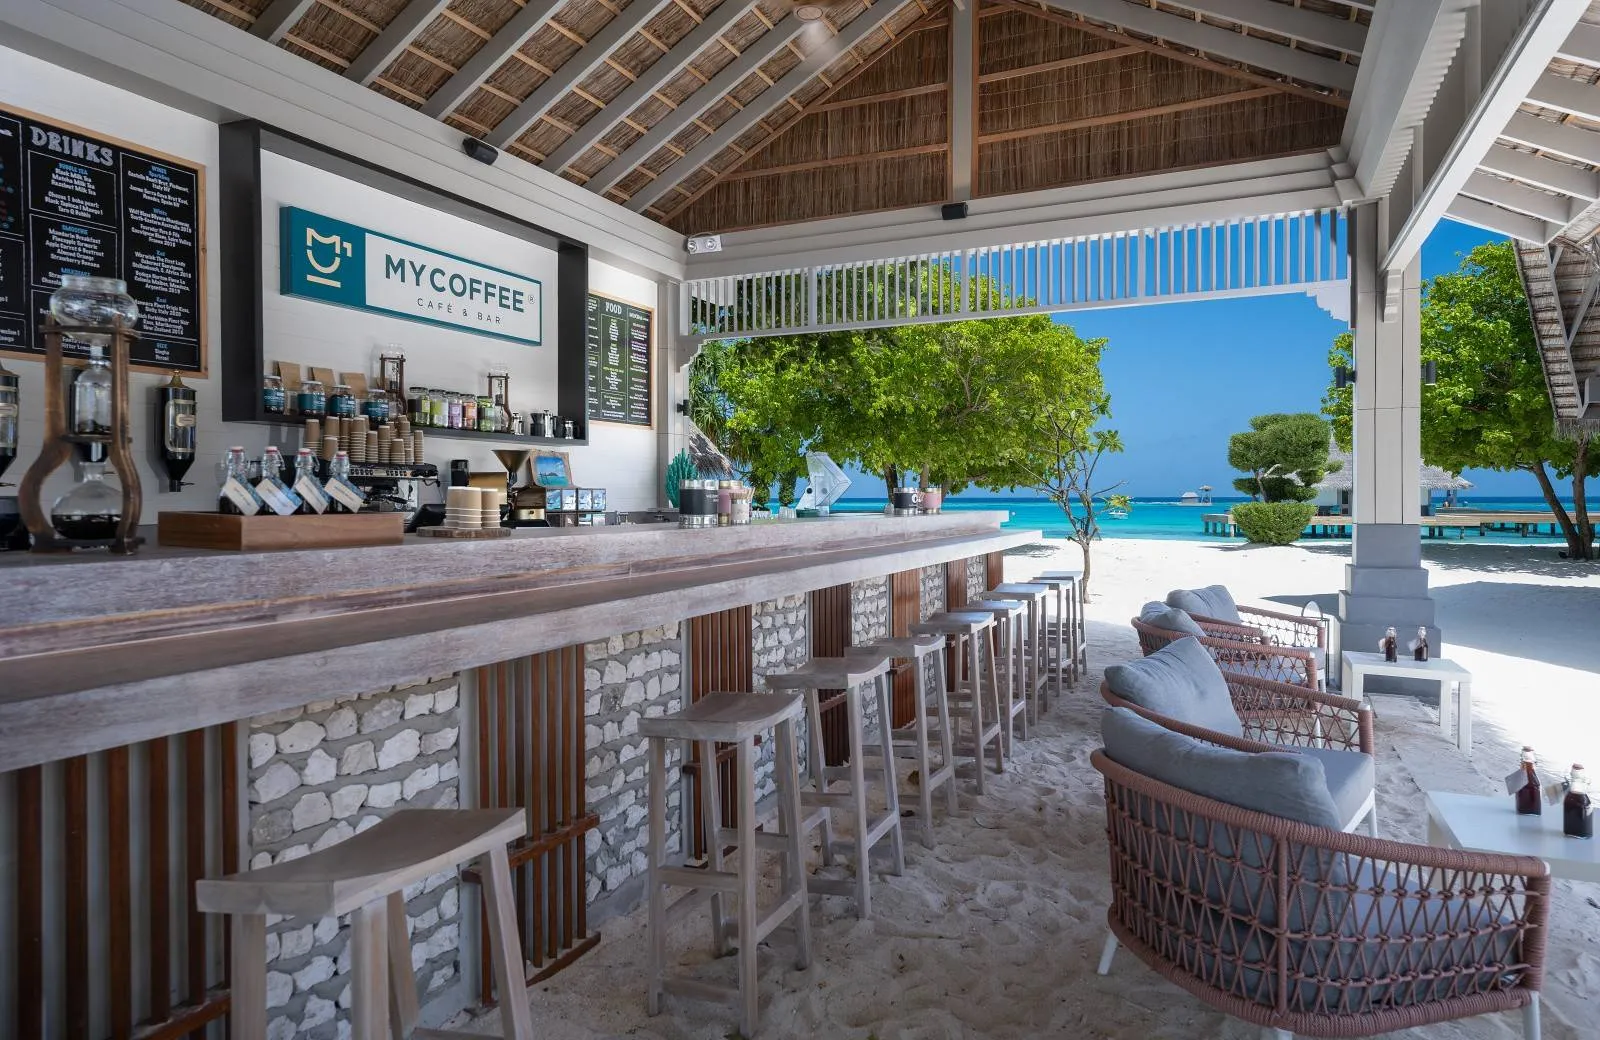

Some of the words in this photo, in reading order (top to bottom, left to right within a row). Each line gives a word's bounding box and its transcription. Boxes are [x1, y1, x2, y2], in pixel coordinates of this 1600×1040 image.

[30, 126, 114, 166] DRINKS
[385, 254, 524, 313] MYCOFFEE
[417, 297, 452, 314] CAFÉ
[462, 308, 468, 317] &
[478, 312, 501, 324] BAR
[606, 302, 622, 314] FOOD
